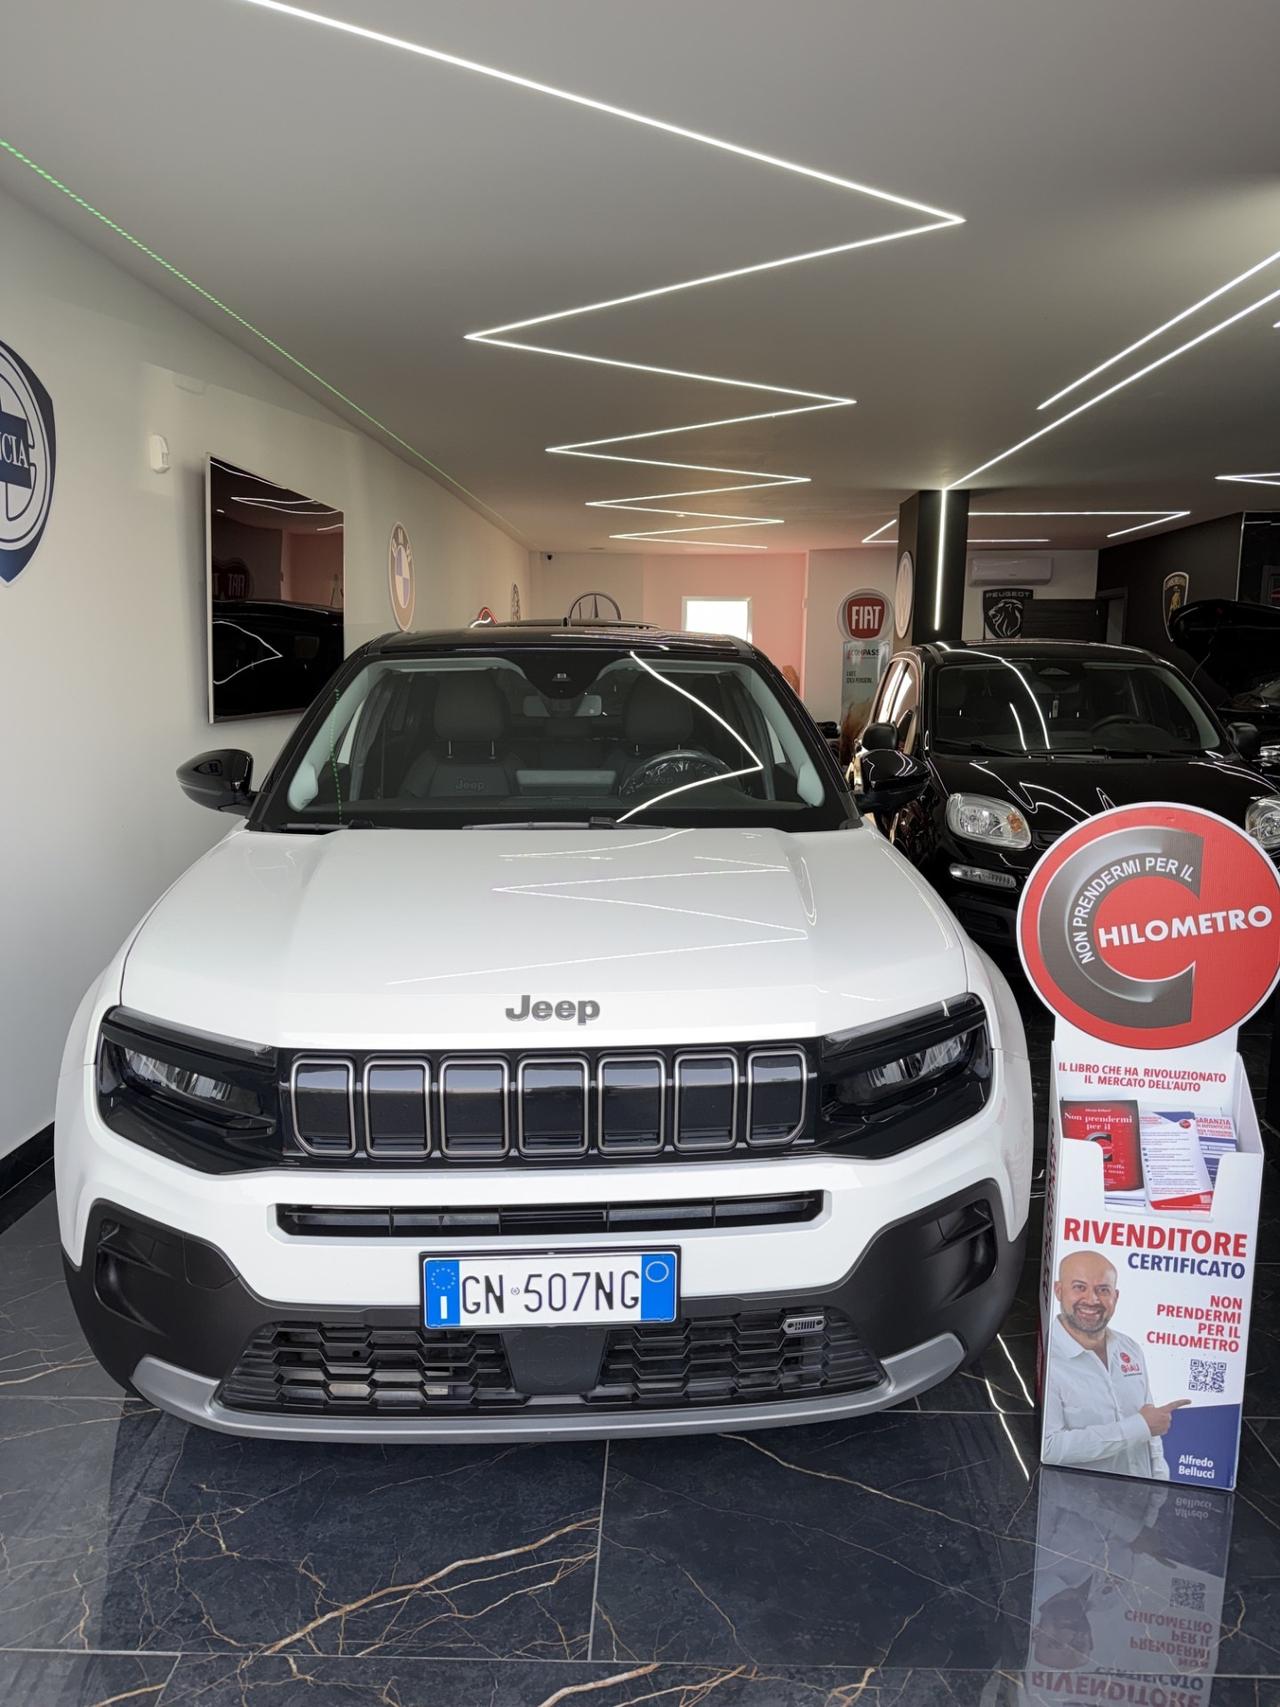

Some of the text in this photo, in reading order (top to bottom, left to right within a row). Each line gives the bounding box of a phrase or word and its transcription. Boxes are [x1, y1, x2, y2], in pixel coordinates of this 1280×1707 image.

[0, 432, 29, 468] CIA
[851, 606, 882, 630] FIAT
[1073, 857, 1194, 964] NON PRENDERMI PER IL
[505, 995, 600, 1025] Jeep
[1059, 1062, 1227, 1083] IL LIBRO CHE HA RIVOLUZIONATO
[1084, 1074, 1201, 1092] IL MERCATO DELL'AUTO
[1065, 1112, 1082, 1120] Non
[1085, 1115, 1132, 1123] prendermi
[1063, 1218, 1248, 1258] RIVENDITORE
[1128, 1252, 1246, 1280] CERTIFICATO
[462, 1274, 504, 1314] GN
[523, 1271, 640, 1313] 507NG
[1210, 1295, 1243, 1310] NON
[1156, 1304, 1242, 1324] PRENDERMI
[1198, 1323, 1241, 1339] PER IL
[1146, 1331, 1240, 1353] CHILOMETRO
[1179, 1454, 1214, 1468] Alfredo
[1178, 1465, 1215, 1479] Bellucci
